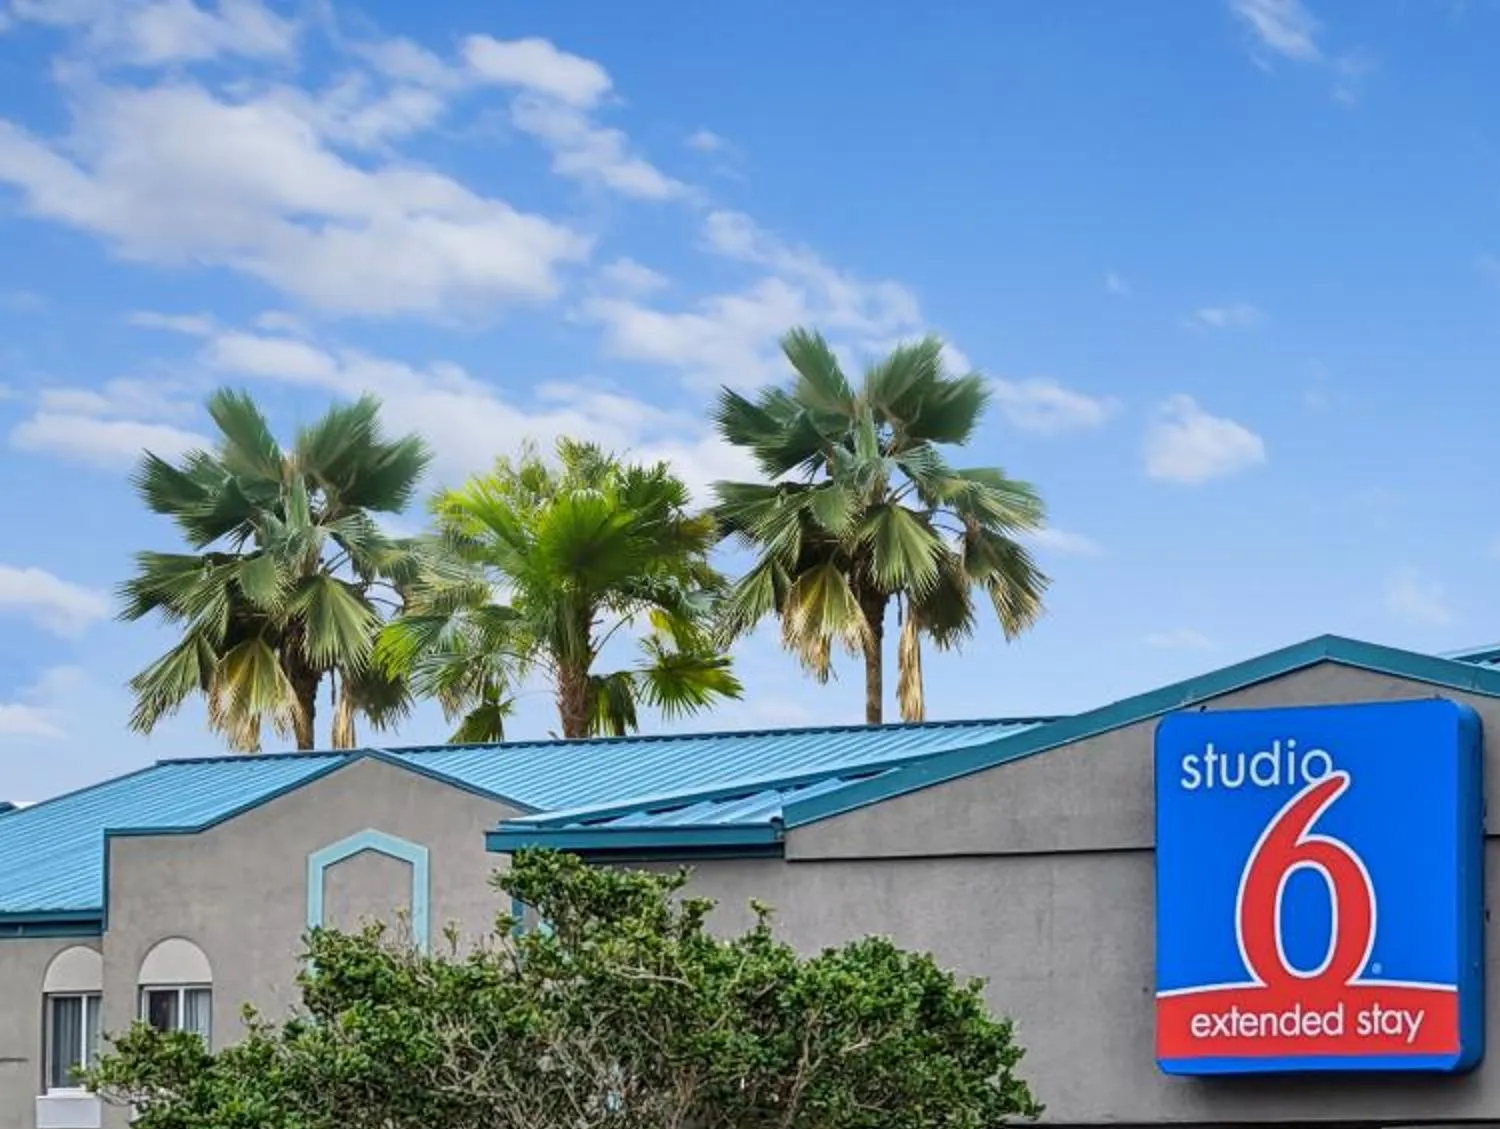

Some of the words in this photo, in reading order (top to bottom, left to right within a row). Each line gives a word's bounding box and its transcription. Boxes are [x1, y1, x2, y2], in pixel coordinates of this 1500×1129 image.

[1181, 739, 1333, 790] studio
[1236, 770, 1377, 986] 6
[1190, 1002, 1344, 1038] extended
[1356, 1002, 1425, 1044] stay
